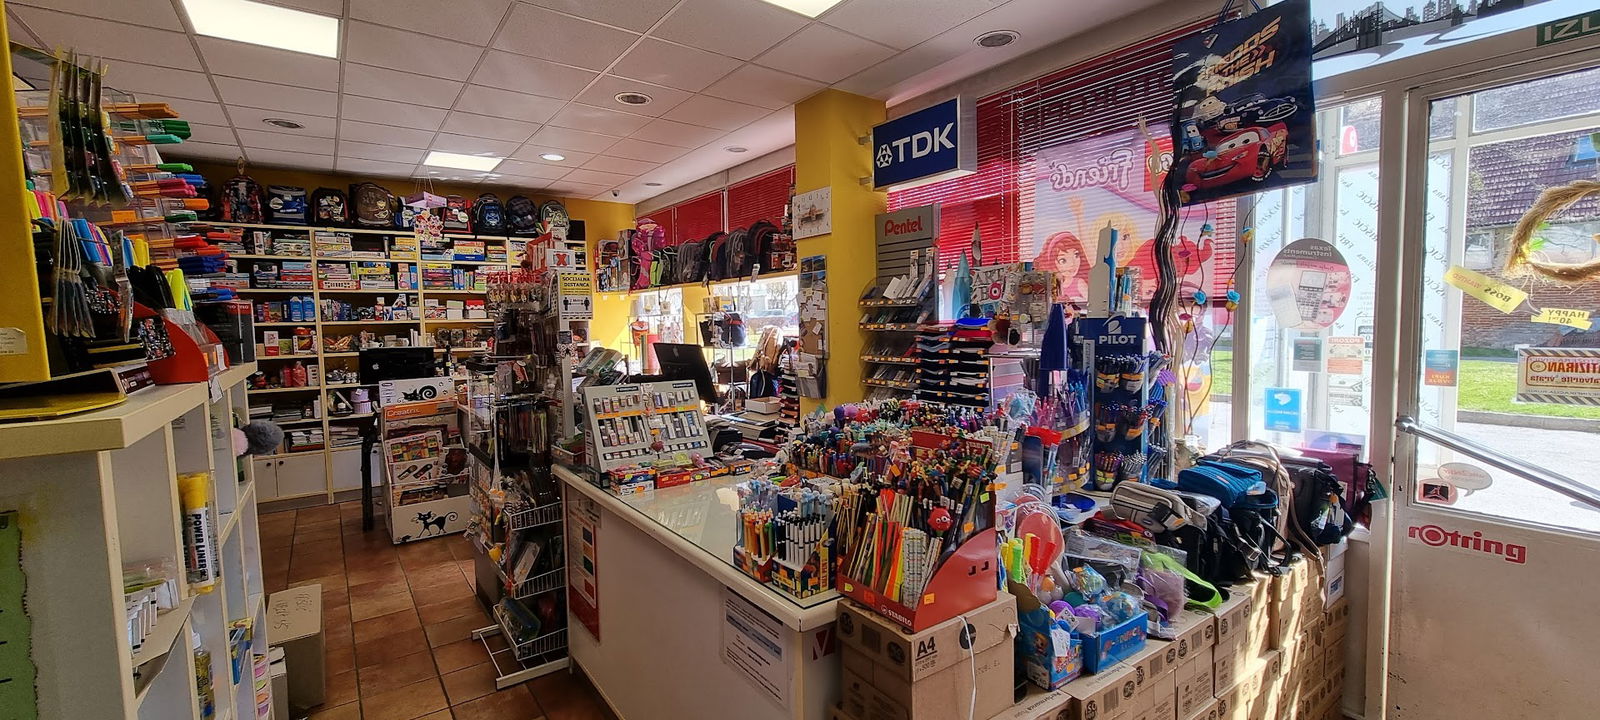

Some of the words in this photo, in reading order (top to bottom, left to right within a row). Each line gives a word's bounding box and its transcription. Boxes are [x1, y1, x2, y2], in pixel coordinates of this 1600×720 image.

[1544, 16, 1600, 41] IZL
[892, 122, 956, 163] TDK
[884, 215, 923, 238] Pentel
[1098, 334, 1137, 345] PILOT
[192, 513, 203, 543] POWER
[195, 543, 207, 570] LINER
[916, 636, 936, 658] A4
